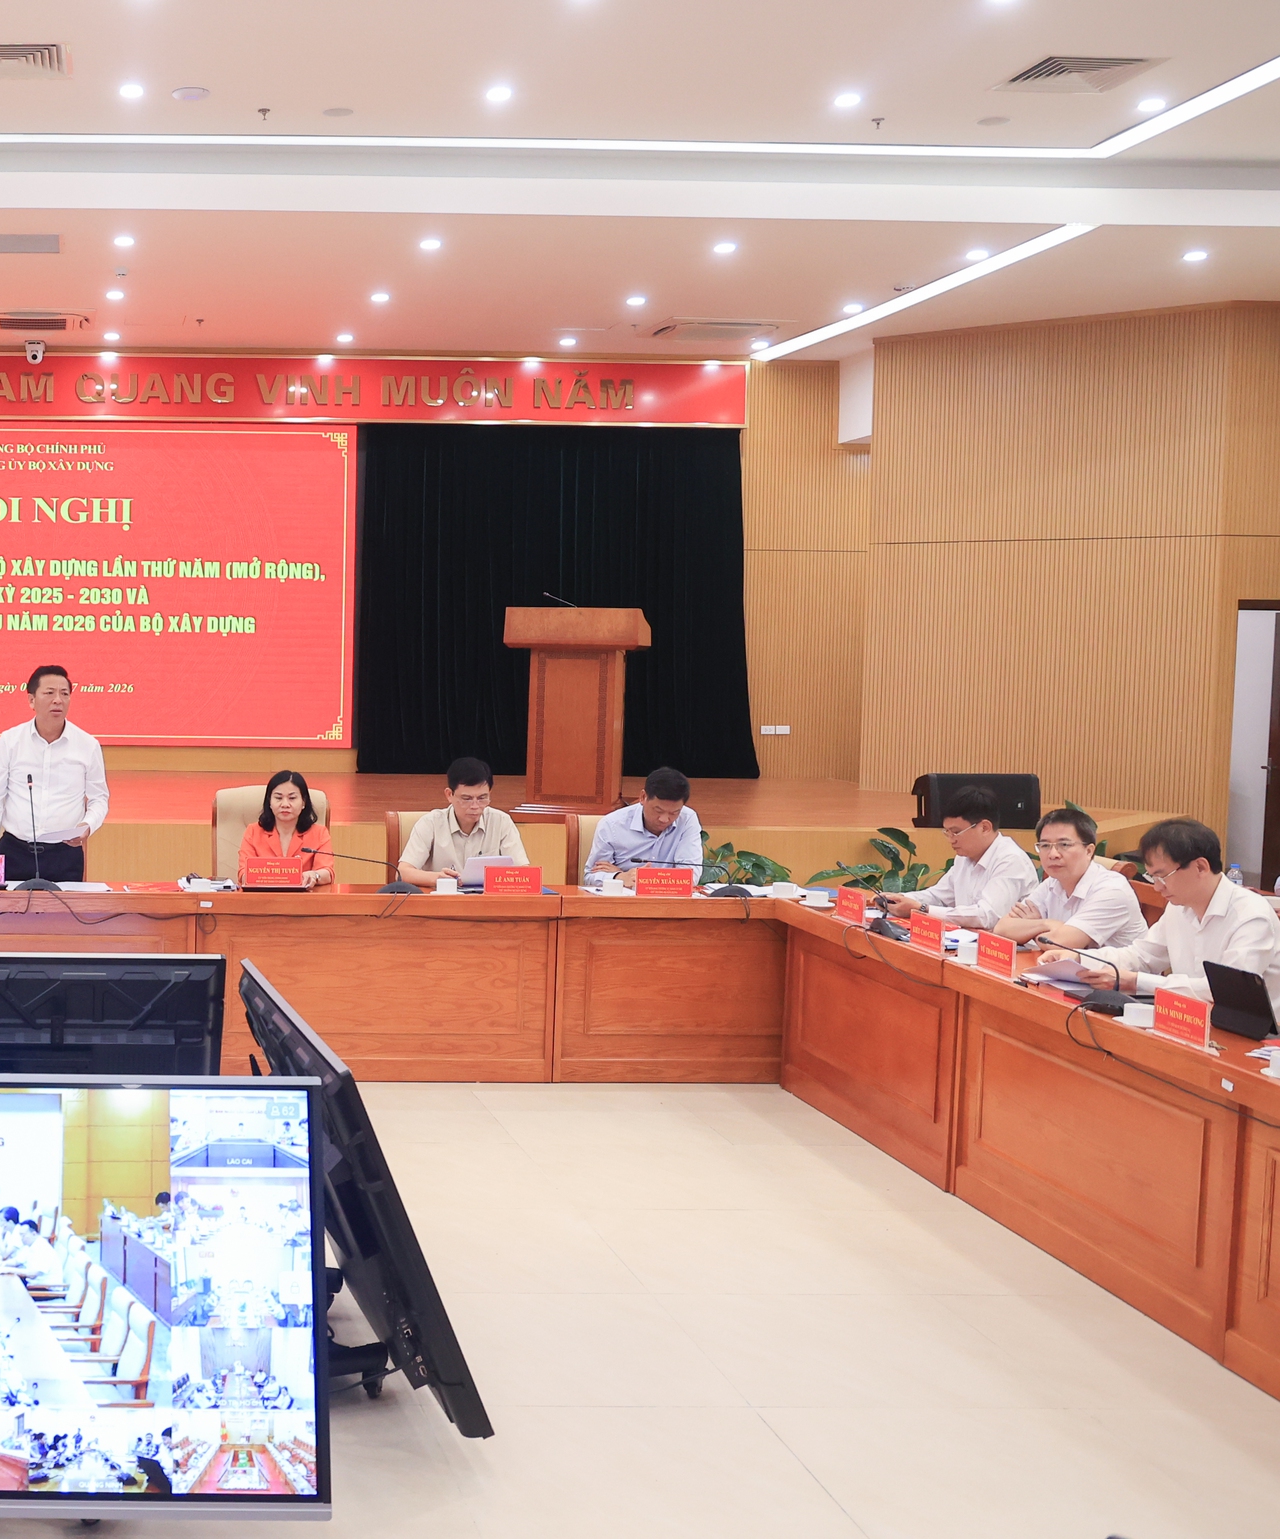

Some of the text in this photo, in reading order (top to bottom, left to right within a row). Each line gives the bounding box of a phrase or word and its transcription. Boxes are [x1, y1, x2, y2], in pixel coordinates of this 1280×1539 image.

[75, 372, 235, 403] QUANG
[256, 373, 360, 406] VINH
[381, 367, 514, 408] MUÔN
[533, 369, 635, 409] NĂM
[16, 443, 34, 456] BỘ
[36, 442, 78, 454] CHÍNH
[80, 442, 106, 454] PHỦ
[8, 458, 26, 471] ỦY
[28, 459, 46, 473] BỘ
[48, 459, 74, 471] XÂY
[77, 460, 114, 473] DỰNG
[32, 497, 134, 531] NGHỊ
[11, 556, 46, 576] XÂY
[50, 558, 98, 580] DỰNG
[102, 555, 137, 577] LẦN
[141, 557, 177, 578] THỨ
[179, 557, 220, 578] NĂM
[225, 556, 261, 580] (MỞ
[265, 559, 326, 582] RỘNG),
[20, 587, 63, 604] 2025
[79, 588, 123, 605] 2030
[126, 584, 150, 605] VÀ
[7, 611, 49, 631] NĂM
[52, 614, 96, 632] 2026
[99, 610, 137, 632] CỦA
[140, 612, 164, 636] BỘ
[168, 612, 203, 633] XÂY
[207, 615, 256, 637] DỰNG
[80, 683, 104, 693] năm
[107, 683, 134, 693] 2026
[1169, 1009, 1183, 1021] MINH
[281, 1106, 295, 1116] 62
